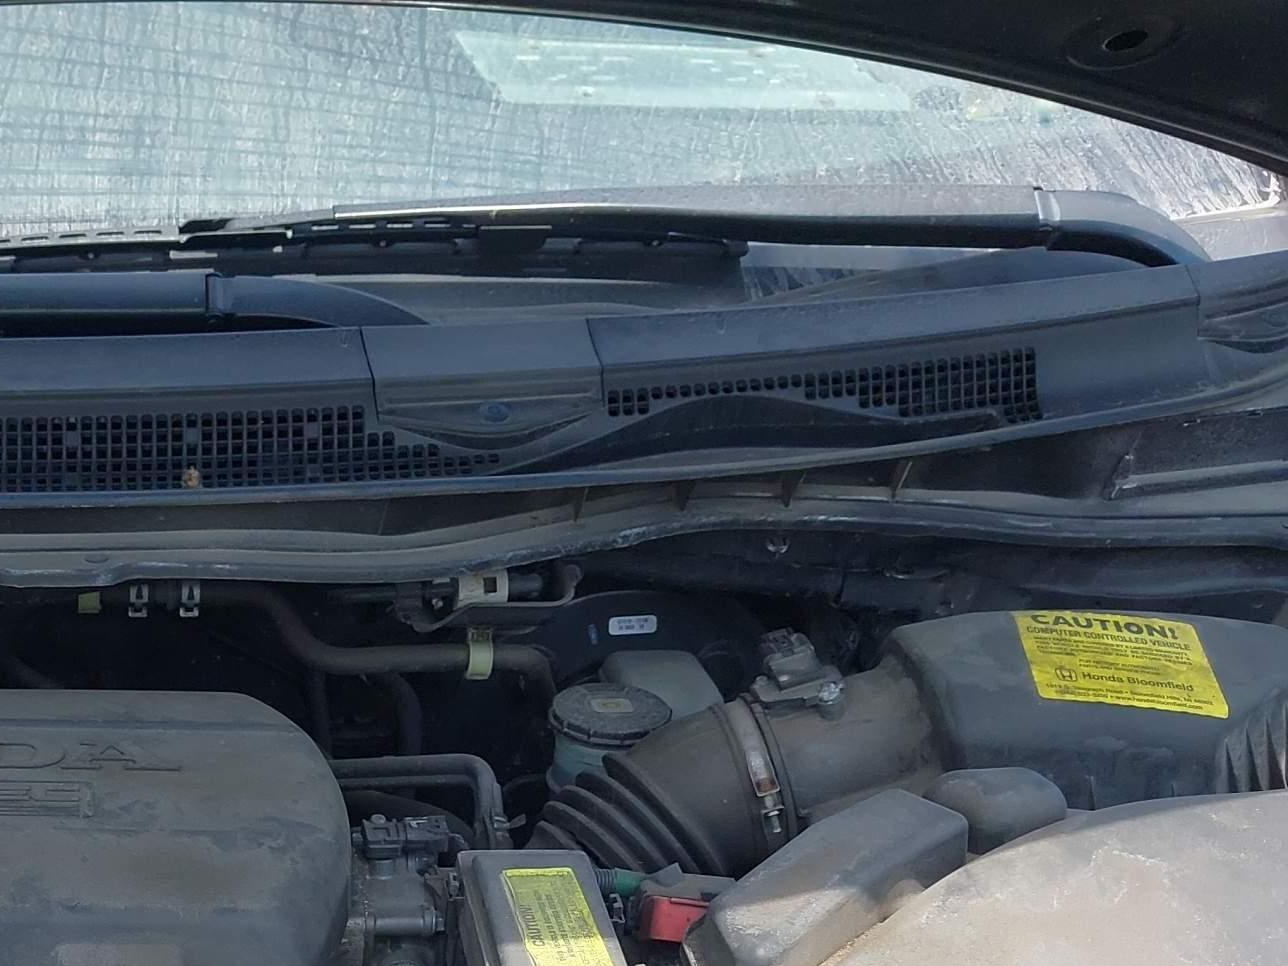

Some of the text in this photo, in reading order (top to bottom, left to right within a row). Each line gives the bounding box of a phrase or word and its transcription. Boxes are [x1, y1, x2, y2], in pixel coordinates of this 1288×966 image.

[1026, 626, 1191, 651] COMPUTER CONTROLLED VEHICLE
[1031, 614, 1178, 640] CAUTION!
[1081, 671, 1124, 683] Honda
[1127, 676, 1194, 692] Bloomfield
